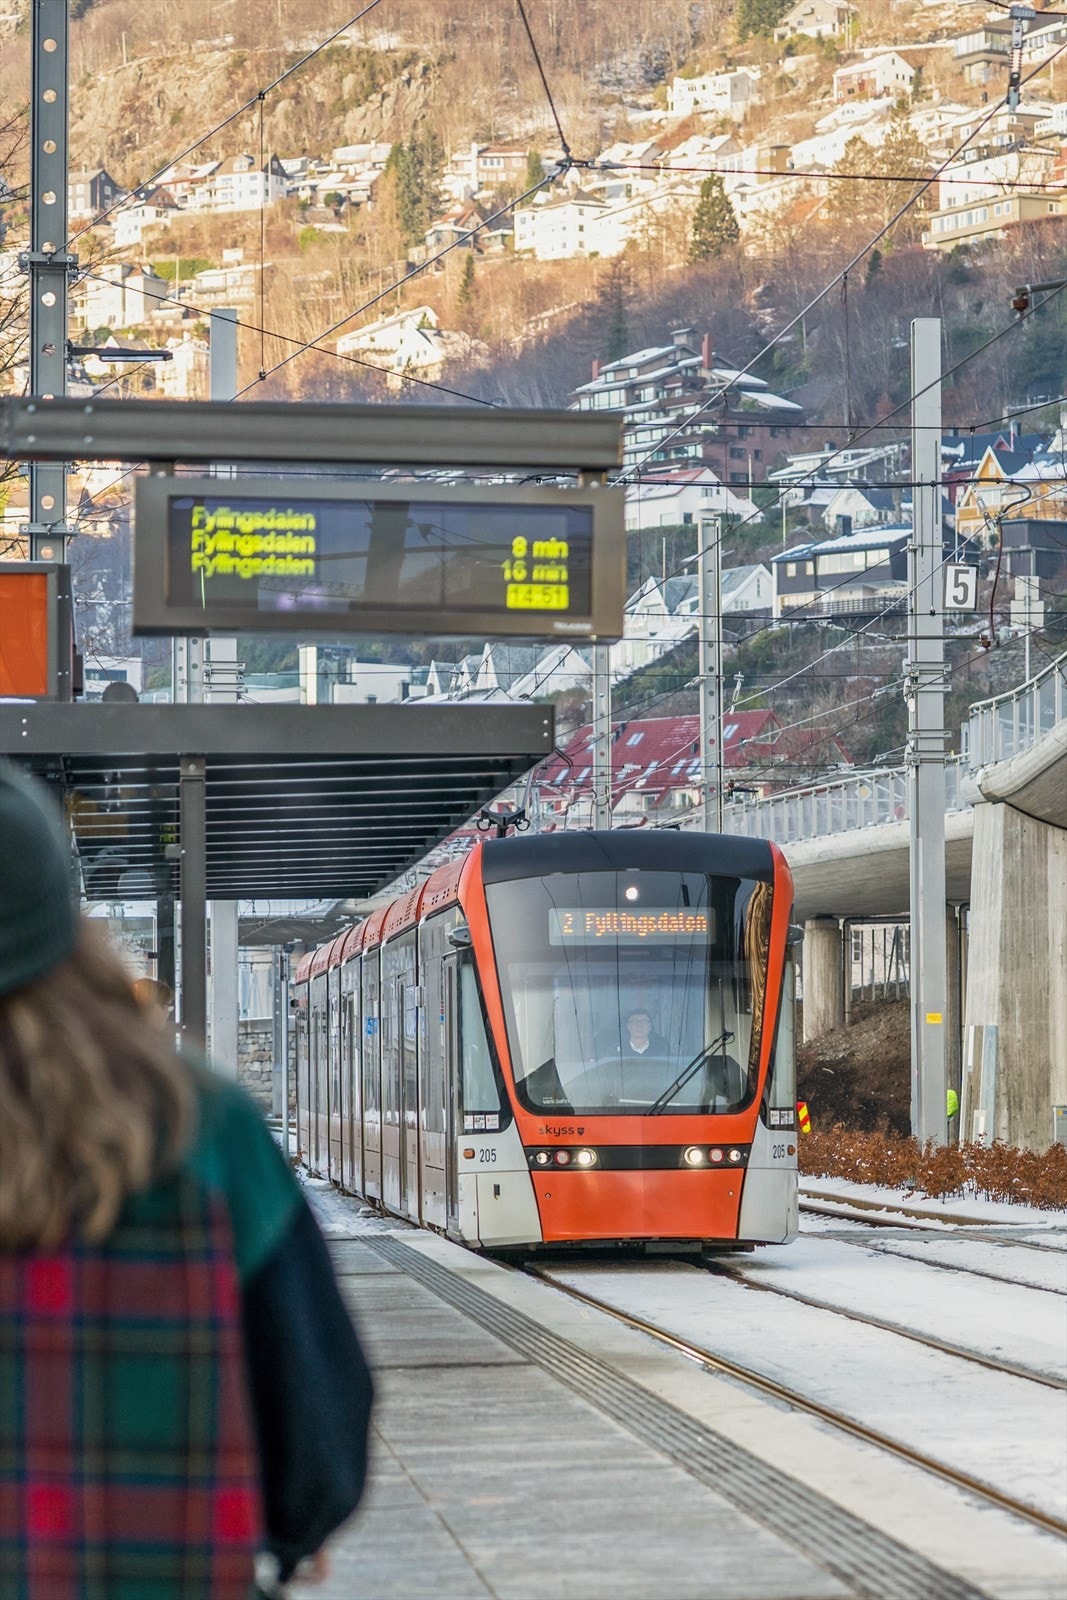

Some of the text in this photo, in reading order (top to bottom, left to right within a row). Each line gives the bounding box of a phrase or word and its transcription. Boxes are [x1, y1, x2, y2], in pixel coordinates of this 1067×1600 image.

[512, 536, 527, 558] 8
[532, 537, 569, 559] min
[501, 559, 527, 582] 16
[532, 561, 569, 582] min
[953, 569, 969, 605] 5
[563, 912, 707, 936] 2 Fyllingsdalen
[539, 1124, 575, 1137] skyss
[480, 1148, 497, 1163] 205
[773, 1144, 786, 1159] 205
